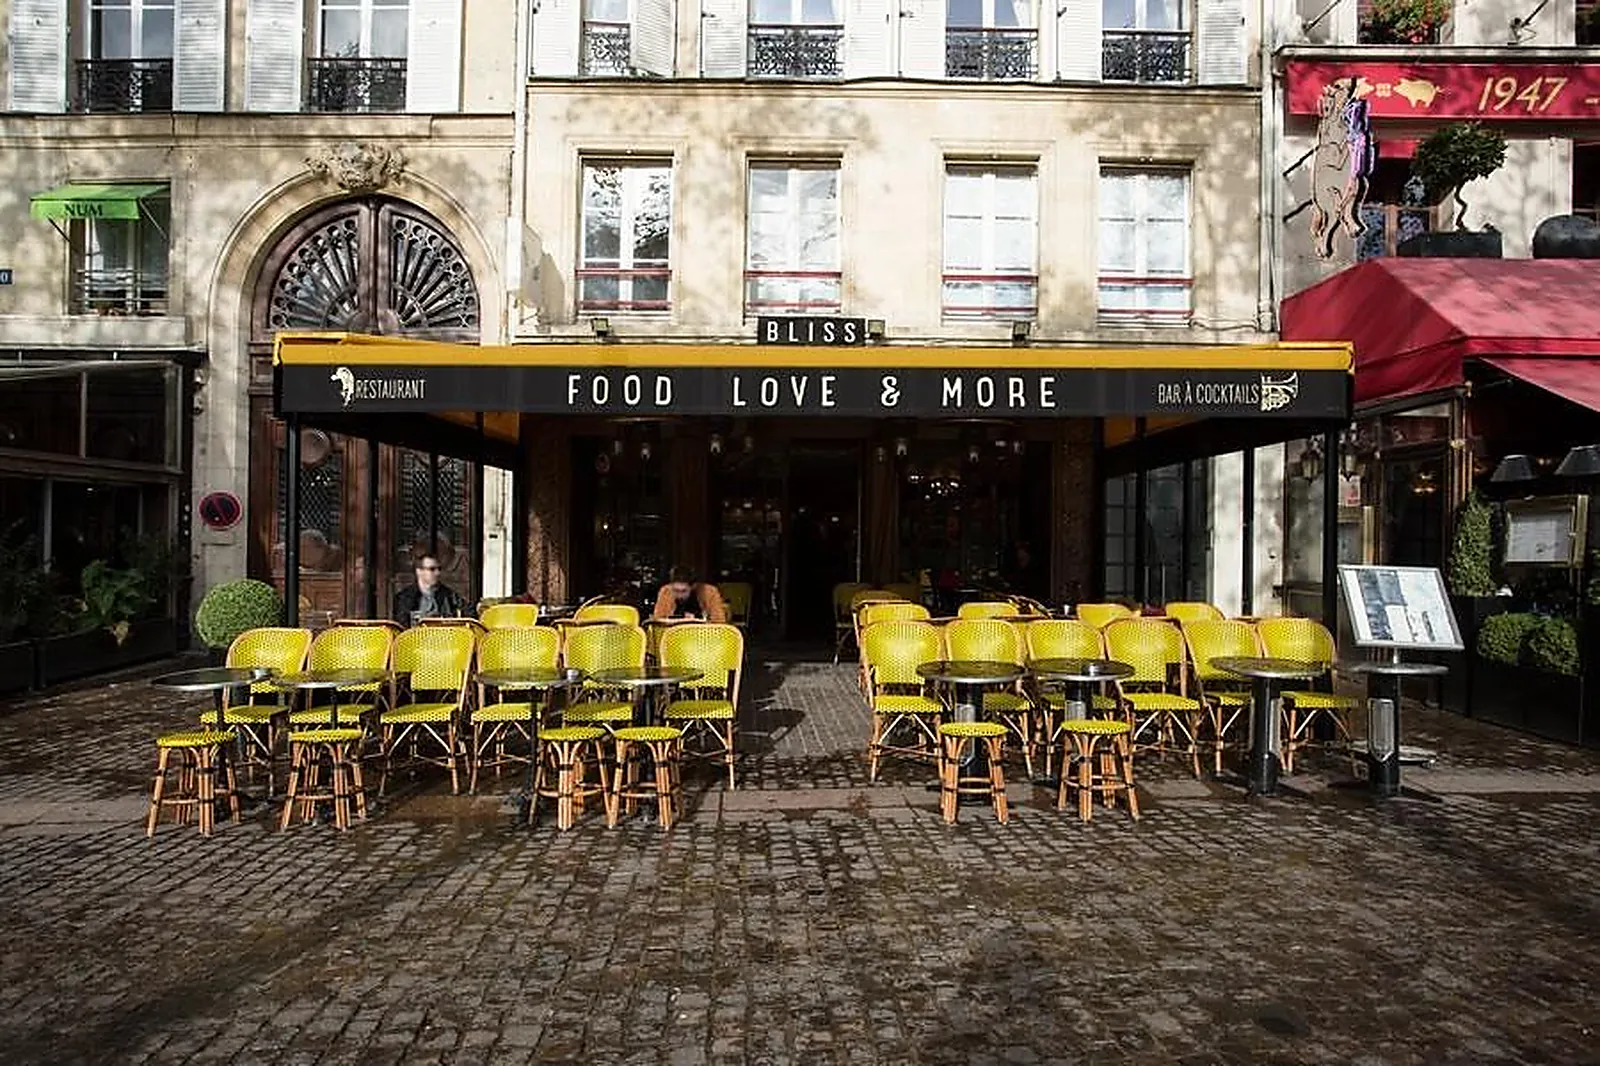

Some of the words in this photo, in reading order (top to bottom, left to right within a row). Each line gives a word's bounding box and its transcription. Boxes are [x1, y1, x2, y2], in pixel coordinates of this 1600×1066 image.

[1479, 76, 1568, 112] 1947
[64, 203, 103, 217] NUM
[766, 320, 857, 343] BLISS
[355, 379, 426, 399] RESTAURANT
[567, 374, 673, 406] FOOD
[733, 376, 836, 407] LOVE
[881, 376, 901, 408] &
[942, 376, 1057, 408] MORE
[1158, 383, 1181, 404] BAR
[1184, 379, 1193, 404] À
[1196, 383, 1260, 404] COCKTAILS
